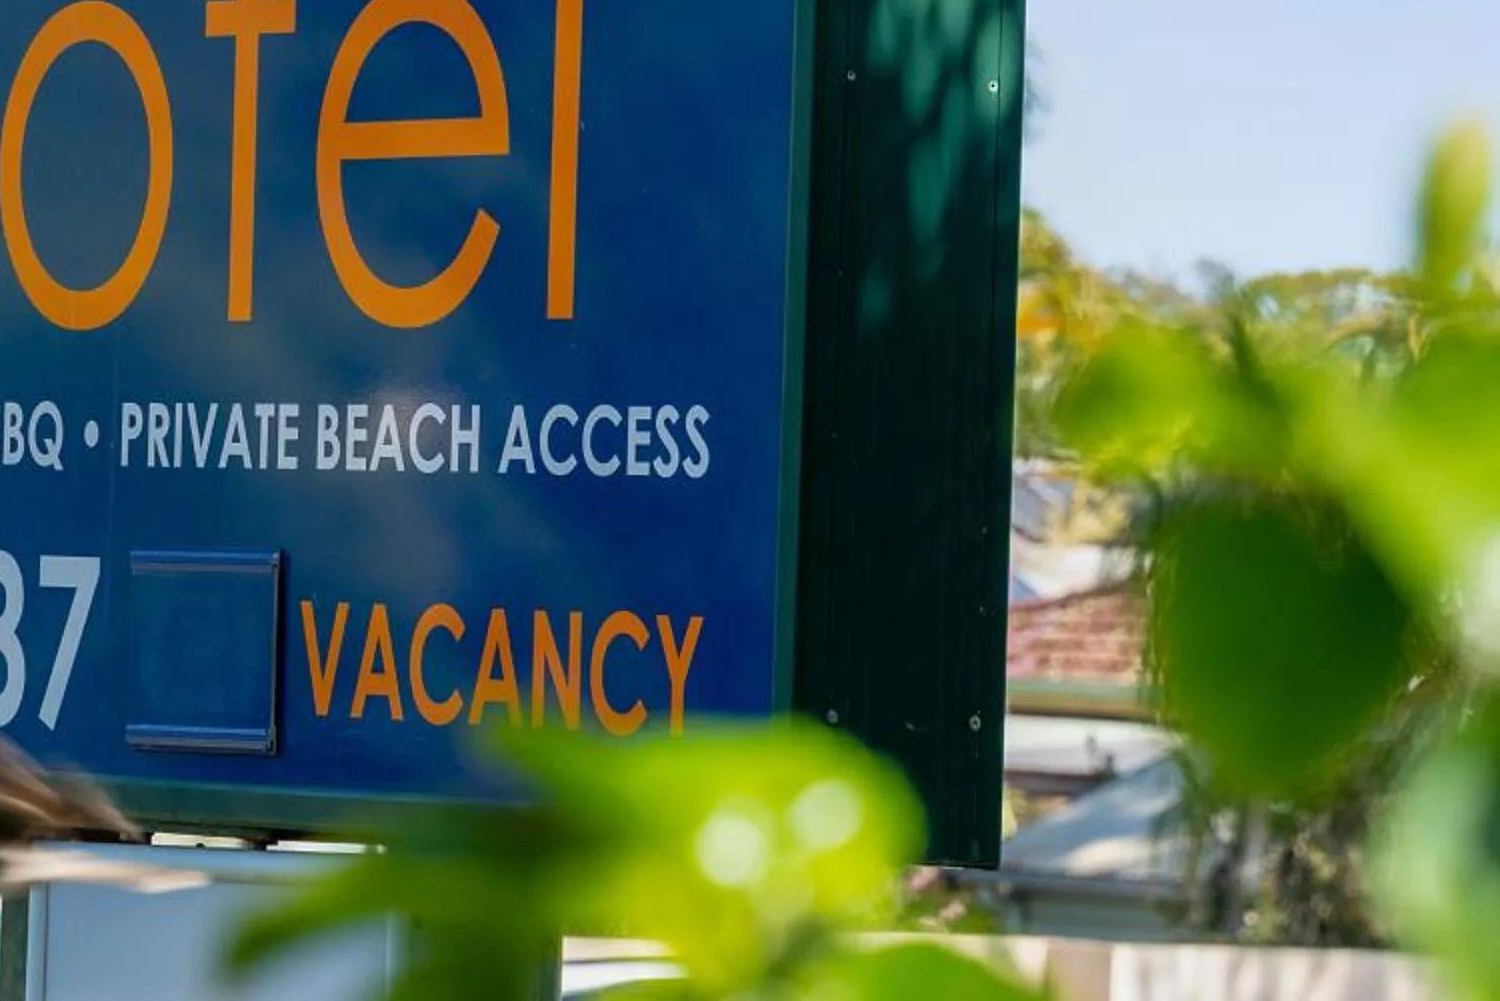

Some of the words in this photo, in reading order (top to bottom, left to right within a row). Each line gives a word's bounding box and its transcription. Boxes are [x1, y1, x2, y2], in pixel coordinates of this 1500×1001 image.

[119, 402, 300, 470] PRIVATE
[315, 403, 480, 474] BEACH
[498, 405, 711, 479] ACCESS
[300, 600, 704, 737] VACANCY
